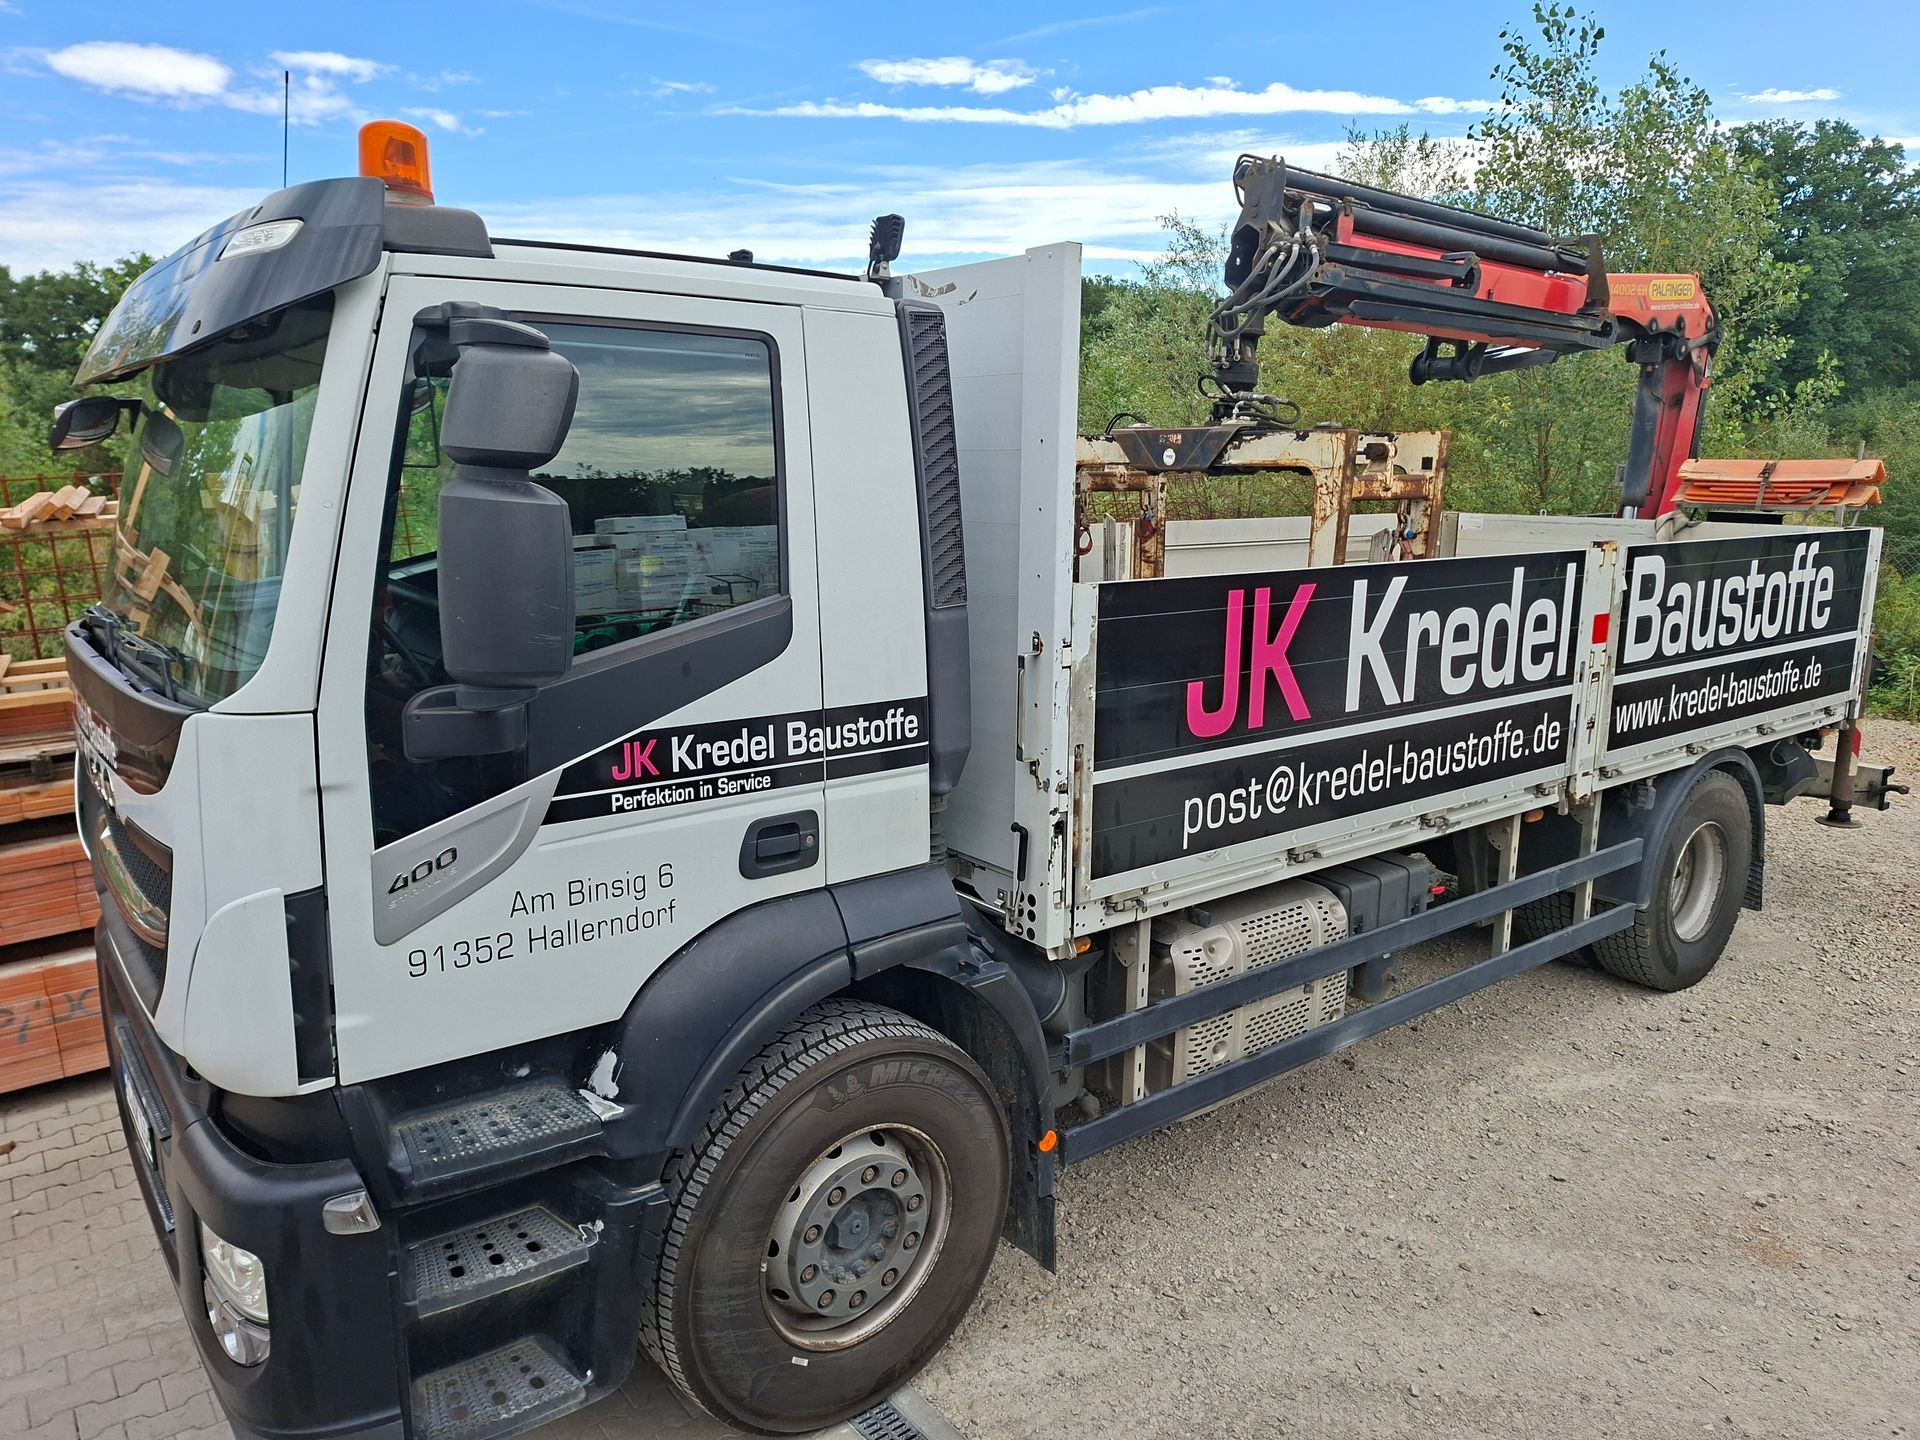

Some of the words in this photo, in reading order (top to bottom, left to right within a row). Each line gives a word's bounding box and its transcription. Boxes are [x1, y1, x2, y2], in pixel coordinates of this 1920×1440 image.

[1651, 282, 1693, 297] PALFINGER
[1186, 583, 1318, 738] JK
[1345, 562, 1577, 713] Kredel
[1623, 541, 1835, 664] Baustoffe
[1616, 655, 1822, 734] www.kredel-baustoffe.de
[611, 739, 660, 782] JK
[671, 724, 775, 773] Kredel
[787, 707, 919, 756] Baustoffe
[1182, 712, 1561, 850] post@kredel-baustoffe.de
[611, 786, 694, 812] Perfektion
[700, 781, 713, 798] in
[718, 773, 771, 795] Service
[387, 846, 457, 895] 400
[510, 890, 555, 918] Am
[568, 869, 646, 907] Binsig
[658, 863, 674, 889] 6
[408, 932, 514, 978] 91352
[528, 898, 677, 953] Hallerndorf
